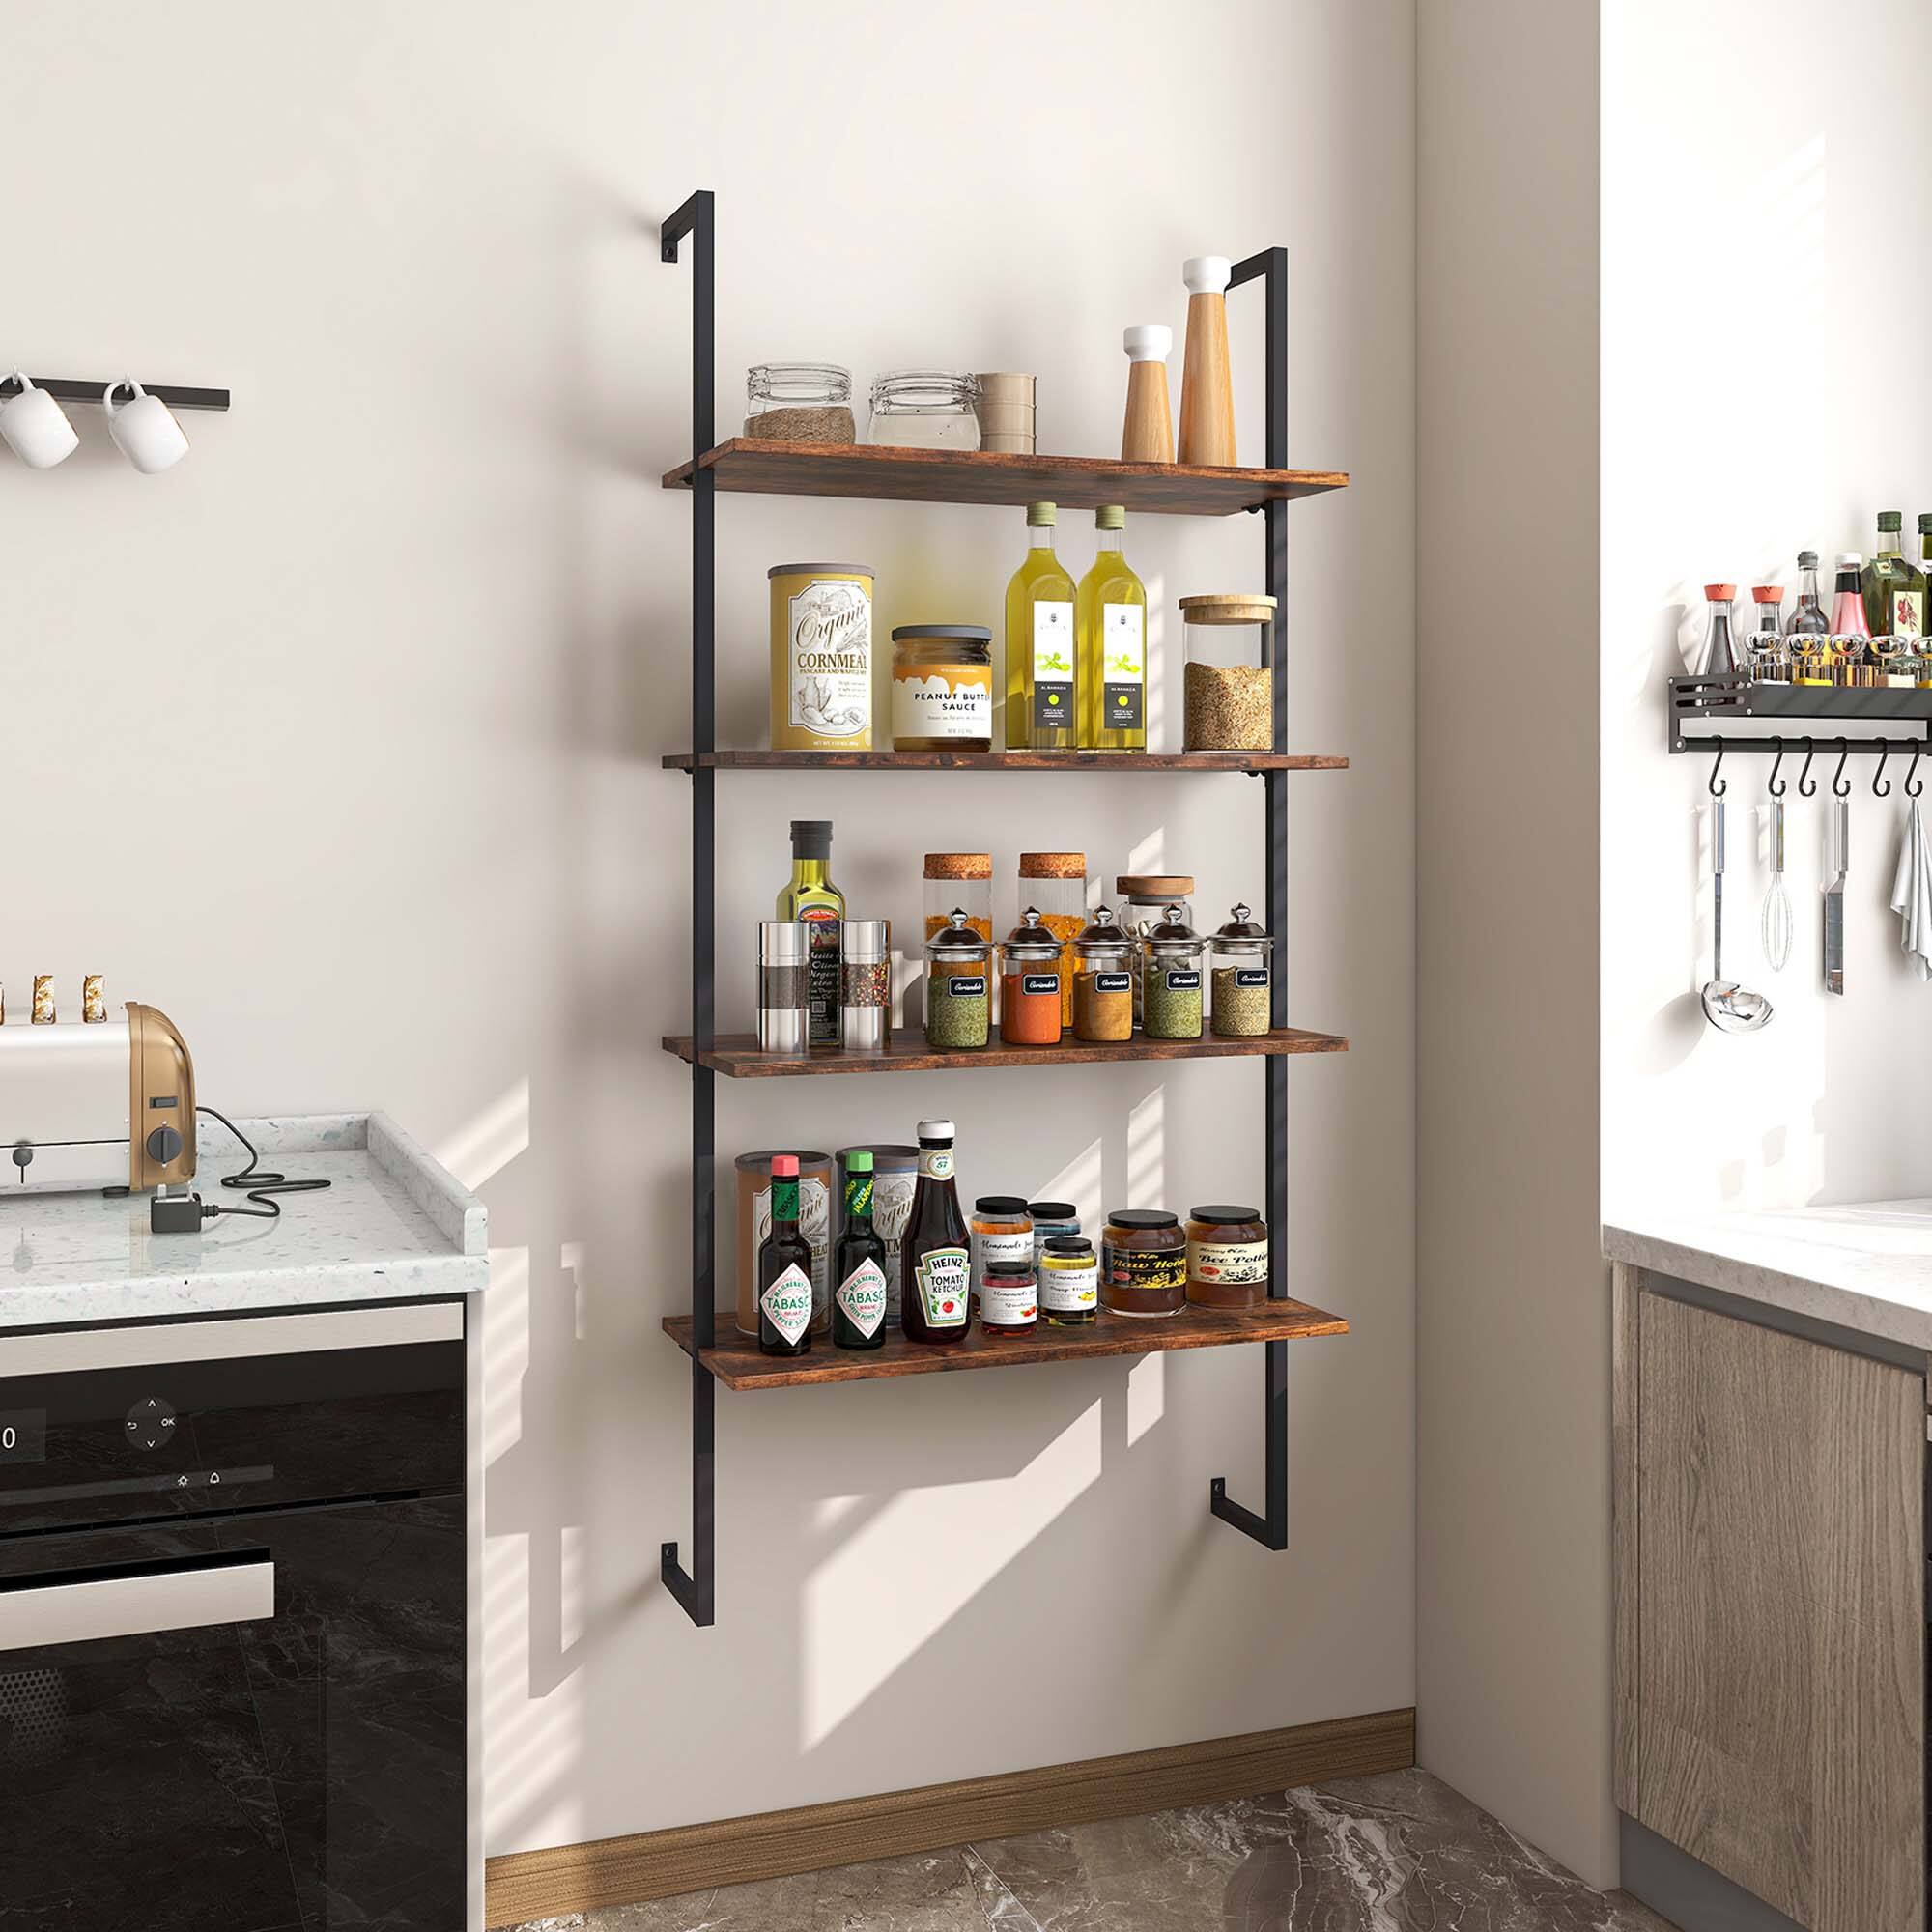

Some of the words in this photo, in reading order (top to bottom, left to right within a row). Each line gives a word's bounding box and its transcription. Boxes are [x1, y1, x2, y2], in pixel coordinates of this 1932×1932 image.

[796, 599, 866, 649] Organic
[797, 653, 867, 668] CORNMEAL
[931, 1257, 964, 1270] HEINZ
[930, 1274, 966, 1286] TOMATO
[932, 1284, 964, 1294] KETCHUP
[160, 1416, 176, 1428] OK
[2, 1427, 16, 1449] 0
